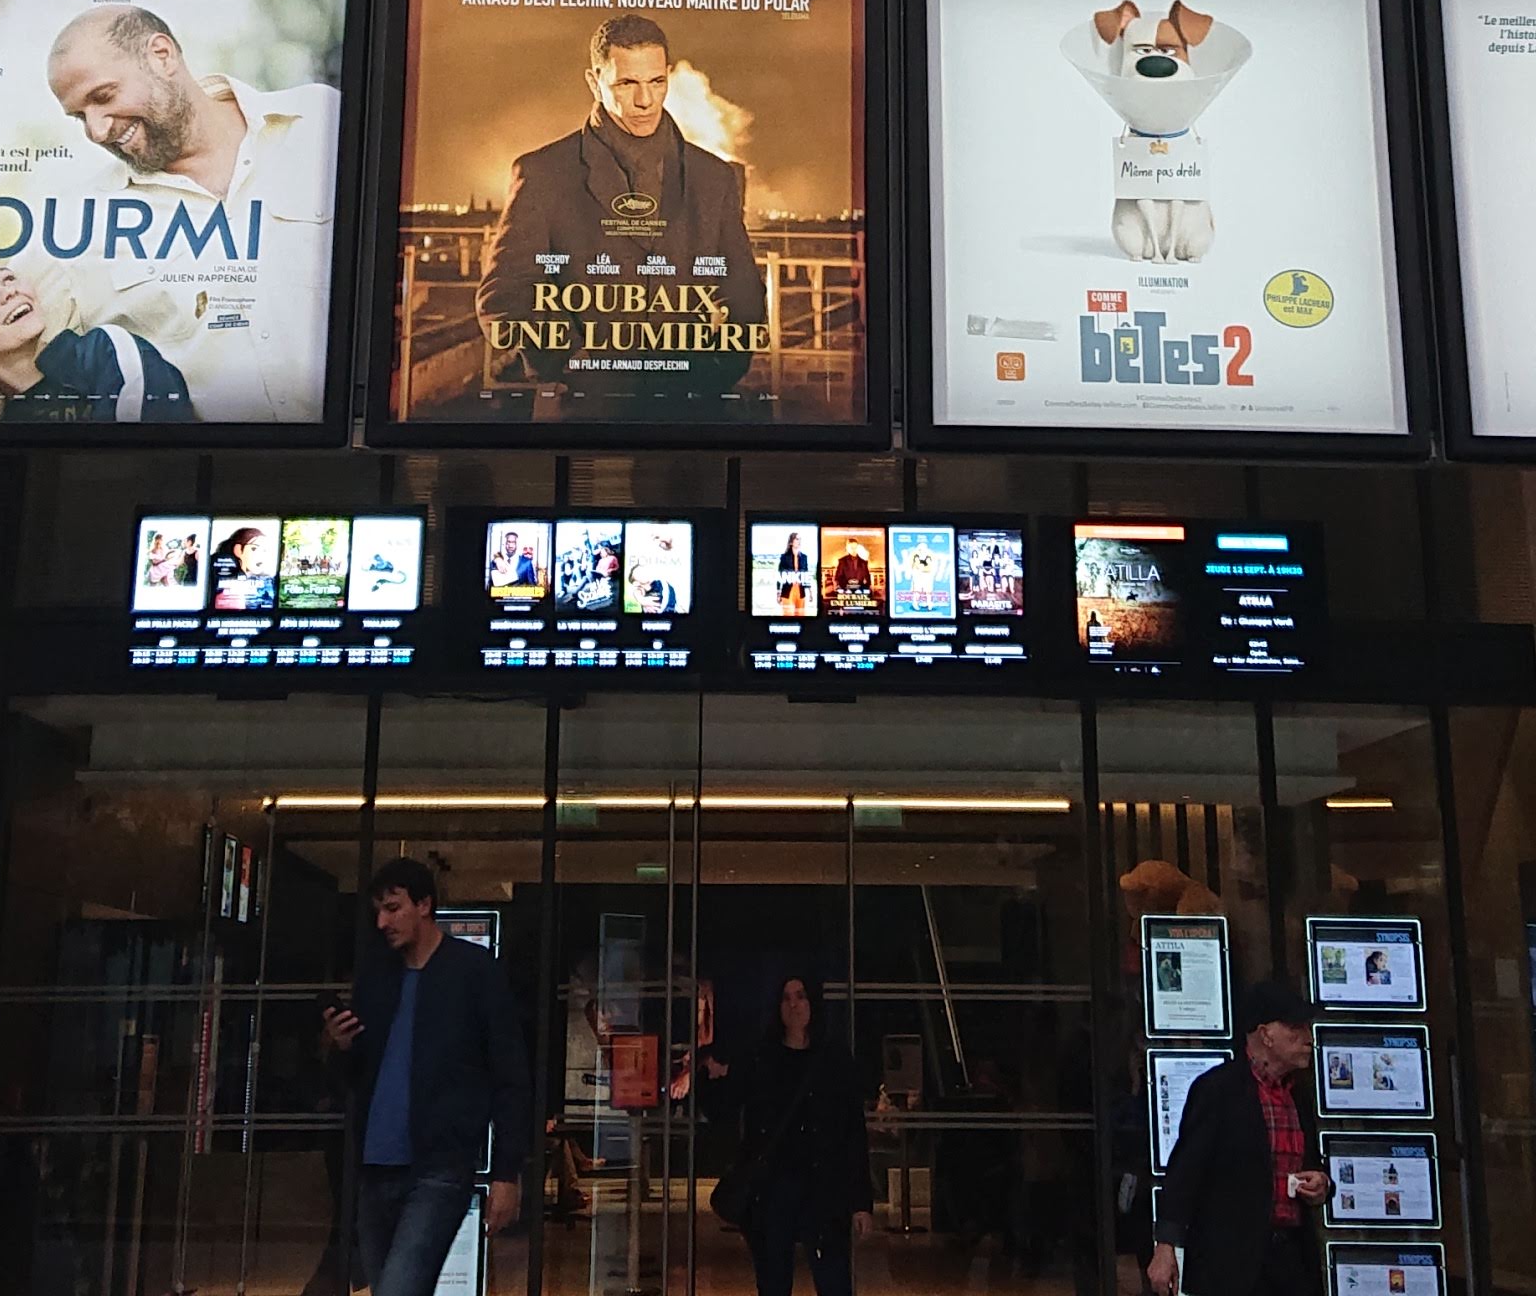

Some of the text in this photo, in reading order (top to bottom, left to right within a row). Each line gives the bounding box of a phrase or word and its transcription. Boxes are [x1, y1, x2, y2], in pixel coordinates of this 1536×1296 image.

[1488, 43, 1525, 56] depuis
[8, 145, 31, 159] est
[35, 145, 74, 163] petit,
[1120, 161, 1201, 184] Même pas drôle
[160, 272, 258, 284] JULIEN RAPPENEAU
[1138, 276, 1189, 289] ILLUMINATION
[532, 282, 729, 320] ROUBAIX,
[1091, 291, 1124, 303] COMME
[1101, 302, 1118, 312] DES
[489, 313, 771, 354] UNE LUMIÈRE
[1223, 325, 1254, 386] 2
[1105, 565, 1161, 581] ATILLA
